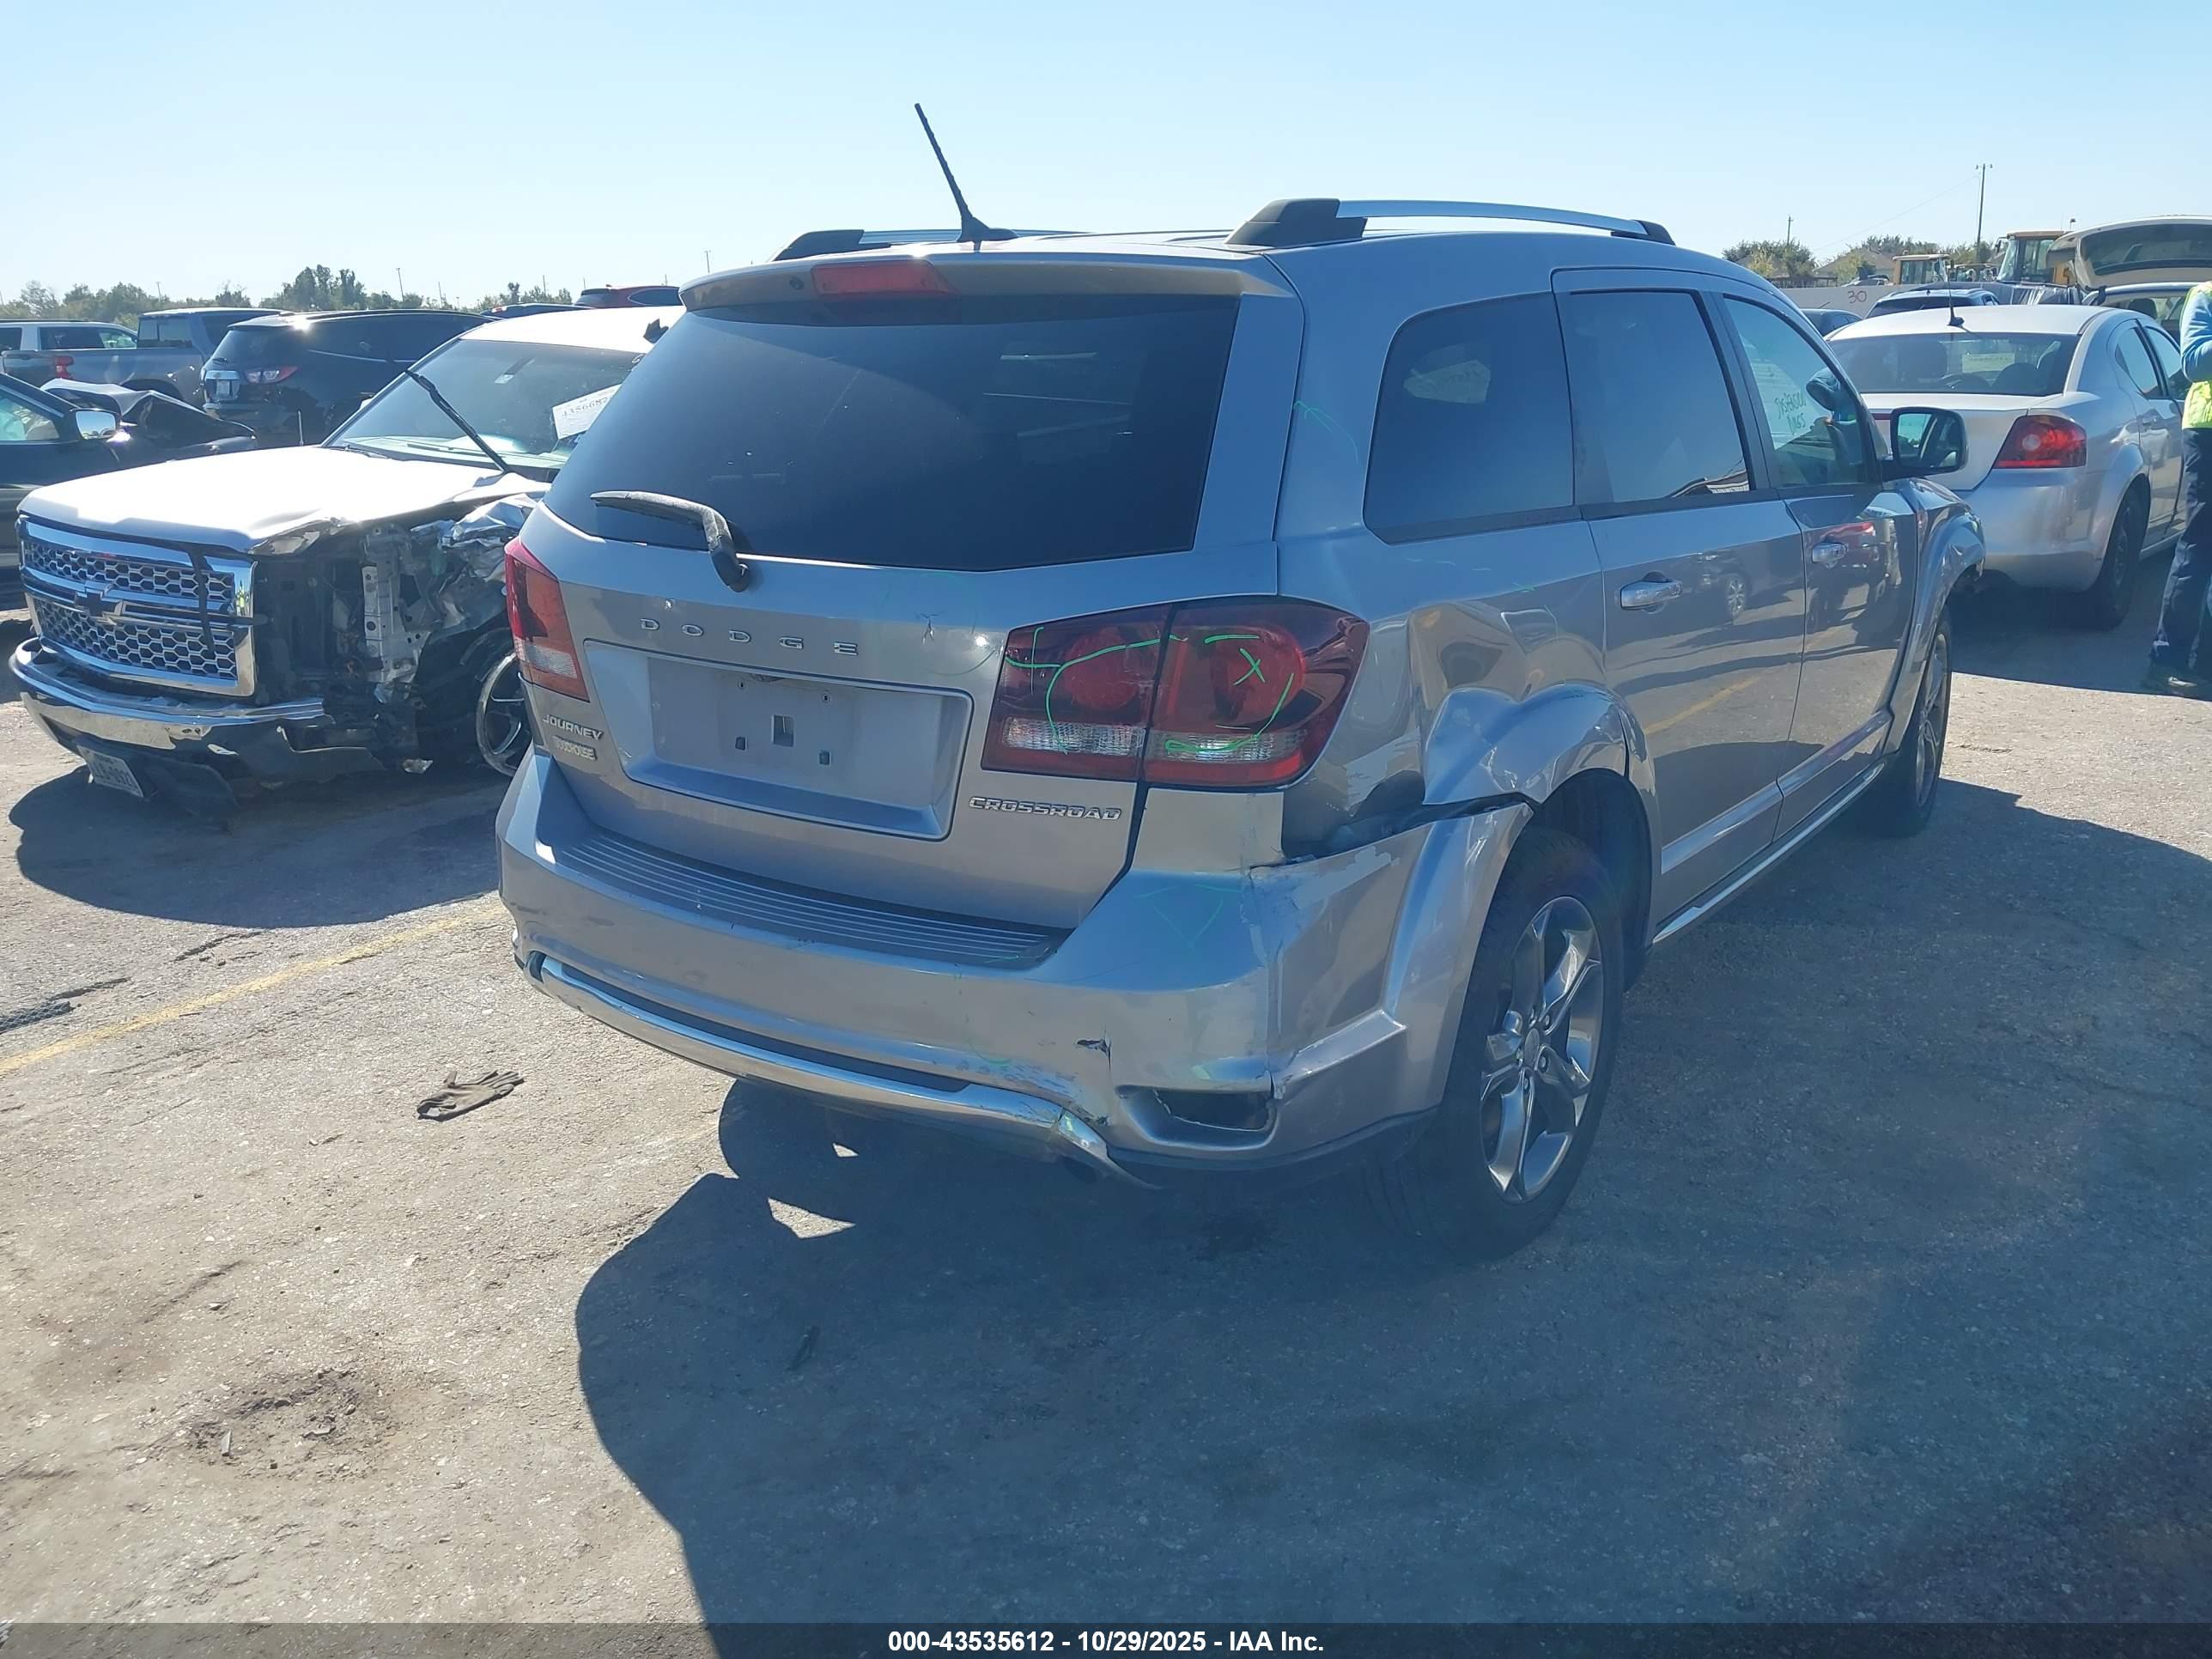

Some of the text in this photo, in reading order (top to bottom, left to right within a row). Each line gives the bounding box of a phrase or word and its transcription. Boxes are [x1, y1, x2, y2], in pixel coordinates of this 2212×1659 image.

[1847, 290, 1868, 304] 30
[640, 617, 859, 656] DODGE
[542, 714, 605, 741] JOURNEY
[968, 795, 1122, 821] CROSSROAD
